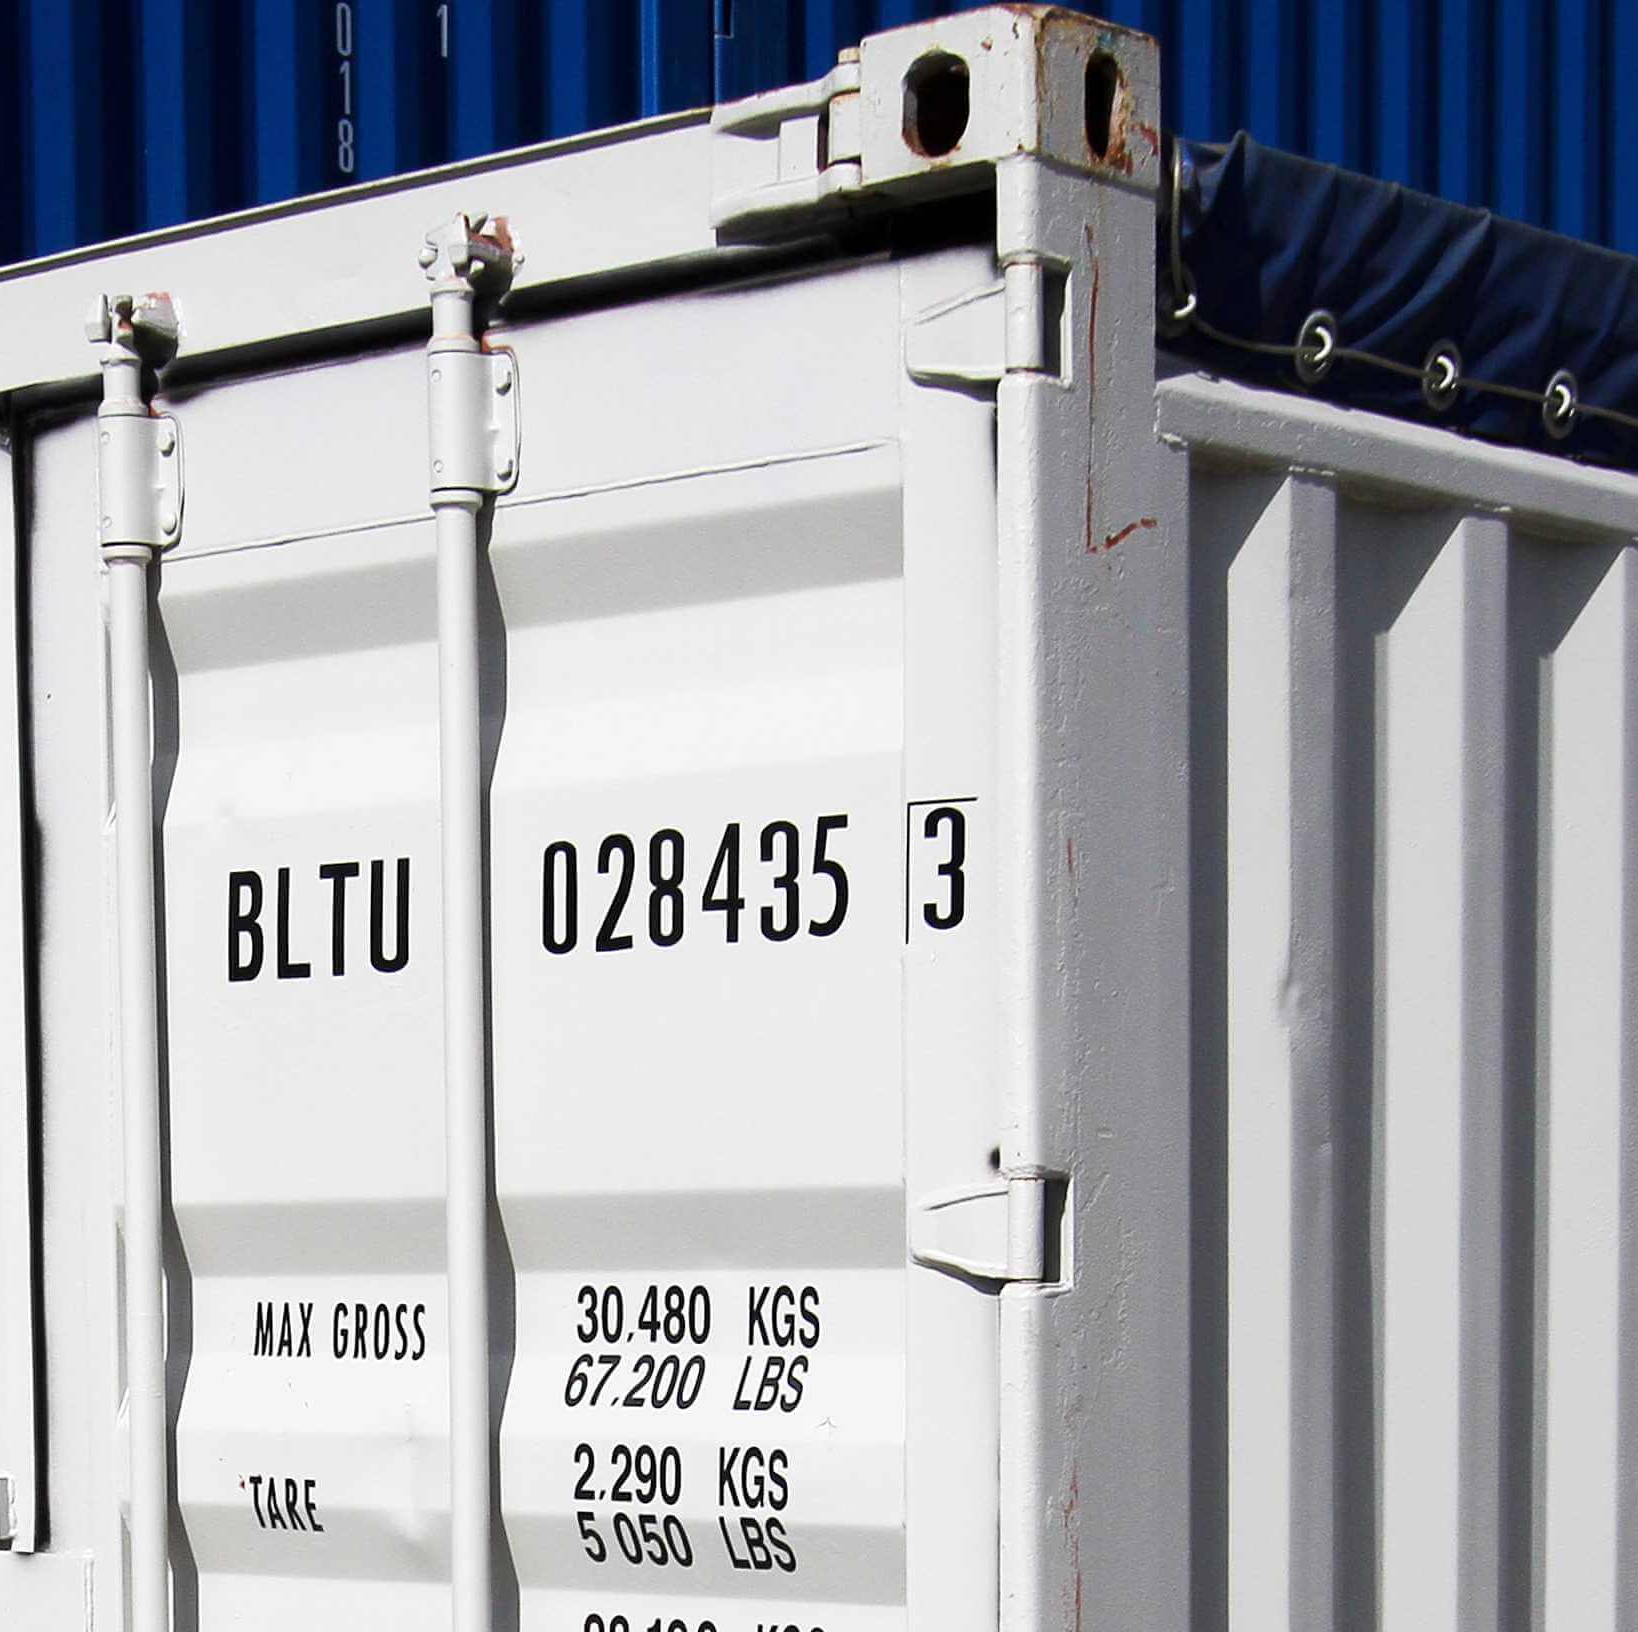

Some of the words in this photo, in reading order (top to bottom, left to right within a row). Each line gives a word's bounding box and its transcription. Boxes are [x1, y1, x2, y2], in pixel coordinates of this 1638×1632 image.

[228, 857, 410, 983] BLTU
[542, 814, 849, 955] 028435
[923, 806, 966, 930] 3
[253, 1301, 313, 1358] MAX
[333, 1302, 426, 1361] GROSS
[748, 1285, 820, 1349] KGS
[733, 1354, 809, 1413] LBS
[249, 1476, 324, 1532] TARE
[719, 1446, 789, 1511] KGS
[718, 1516, 797, 1573] LBS
